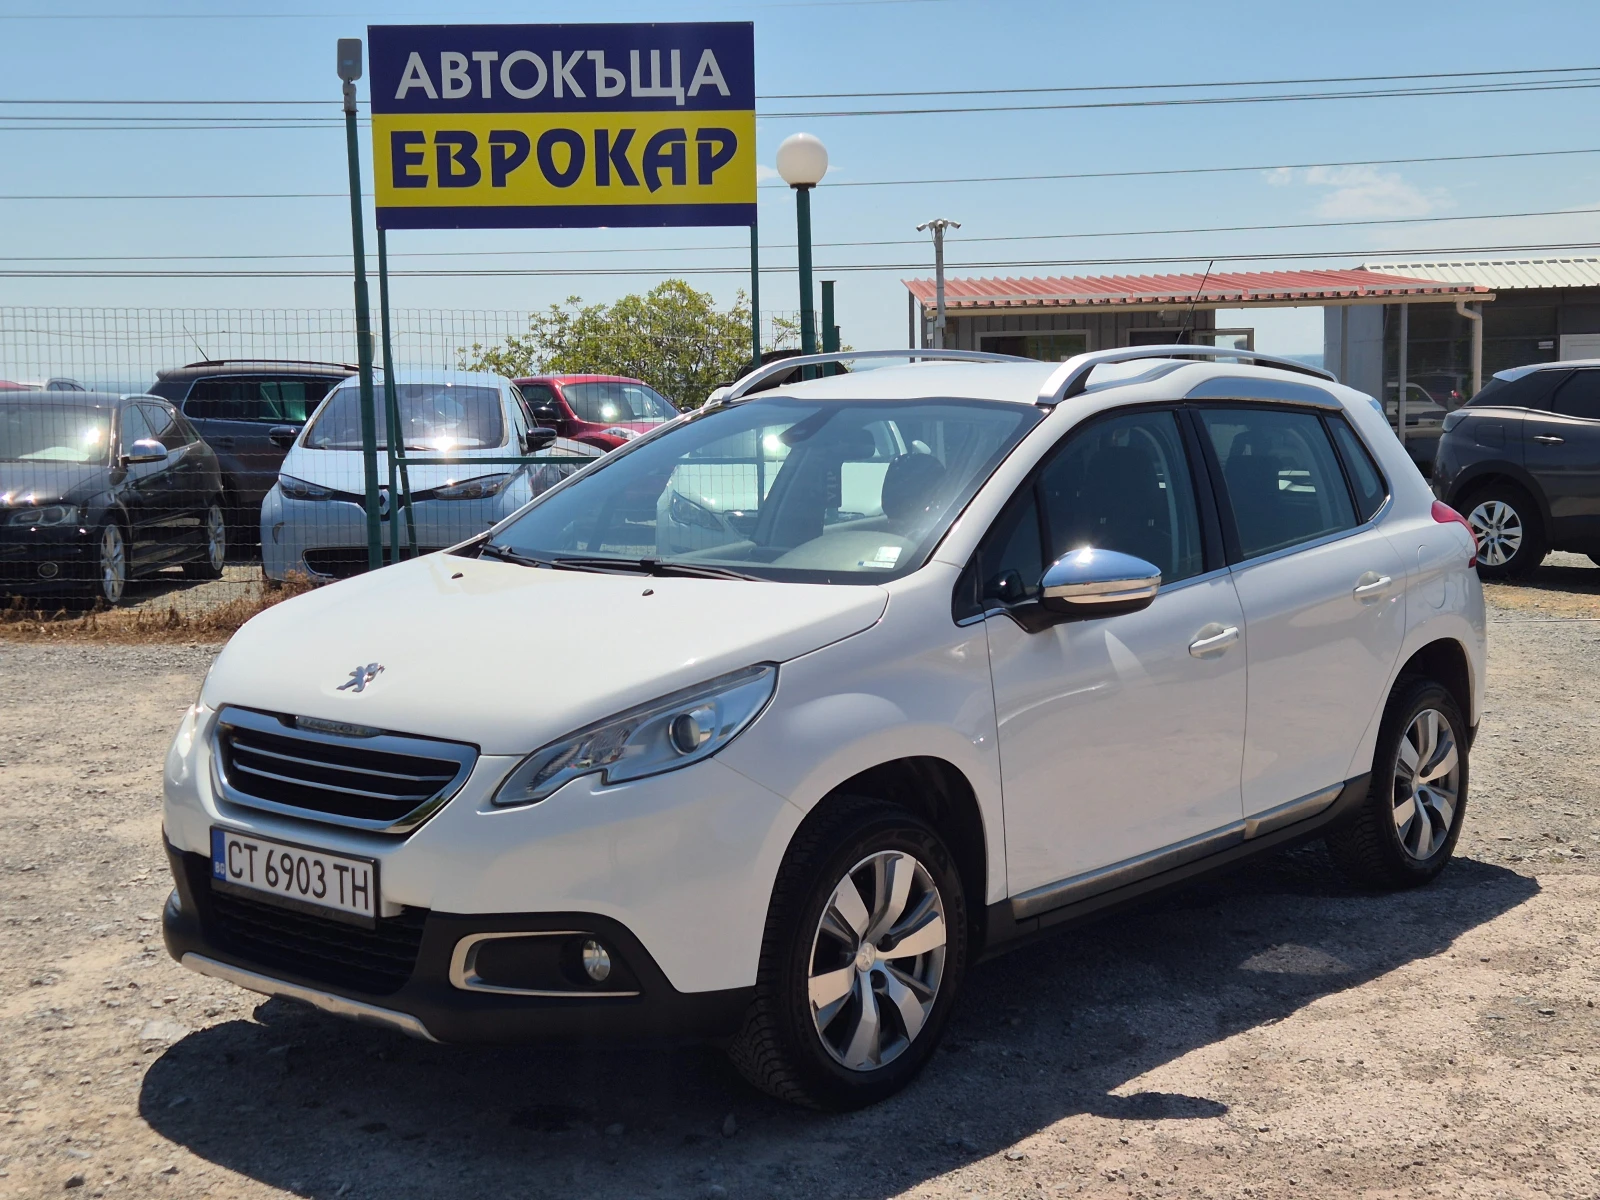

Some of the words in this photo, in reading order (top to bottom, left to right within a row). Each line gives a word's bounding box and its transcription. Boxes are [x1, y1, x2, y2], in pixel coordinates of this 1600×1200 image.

[394, 48, 731, 106] АВТОКЪЩА
[390, 127, 738, 194] ЕВРОКАР
[215, 861, 225, 875] BG
[228, 840, 258, 883] CT
[265, 849, 327, 899] 6903
[333, 863, 369, 911] TH
